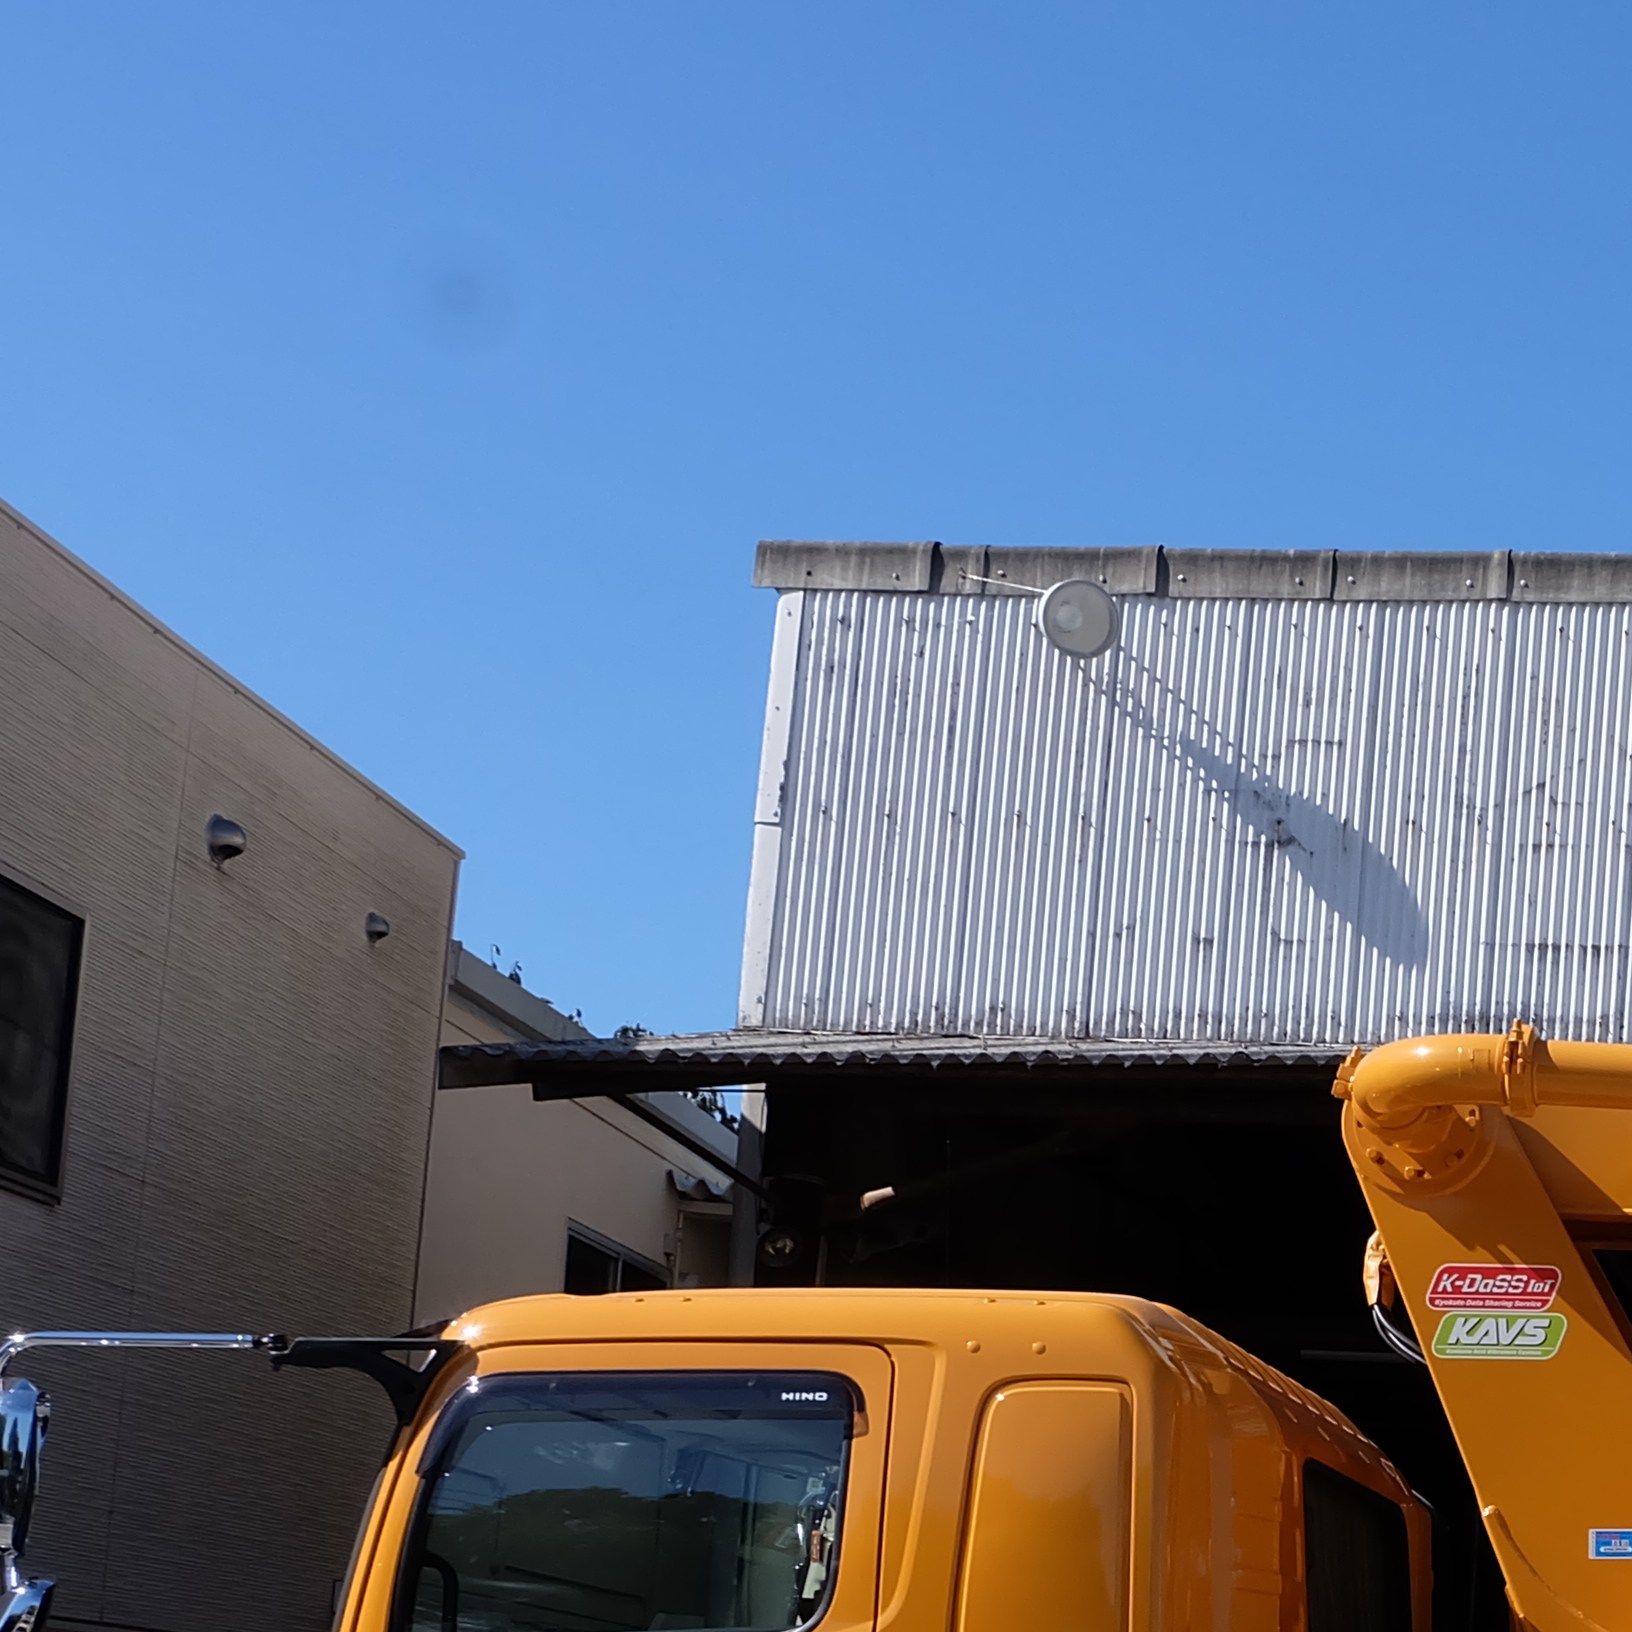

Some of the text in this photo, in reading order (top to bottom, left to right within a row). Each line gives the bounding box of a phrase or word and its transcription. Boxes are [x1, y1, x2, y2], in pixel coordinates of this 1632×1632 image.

[1437, 1274, 1555, 1293] K-DaSS IoT
[1447, 1317, 1550, 1345] KAVS
[781, 1392, 828, 1401] HINO
